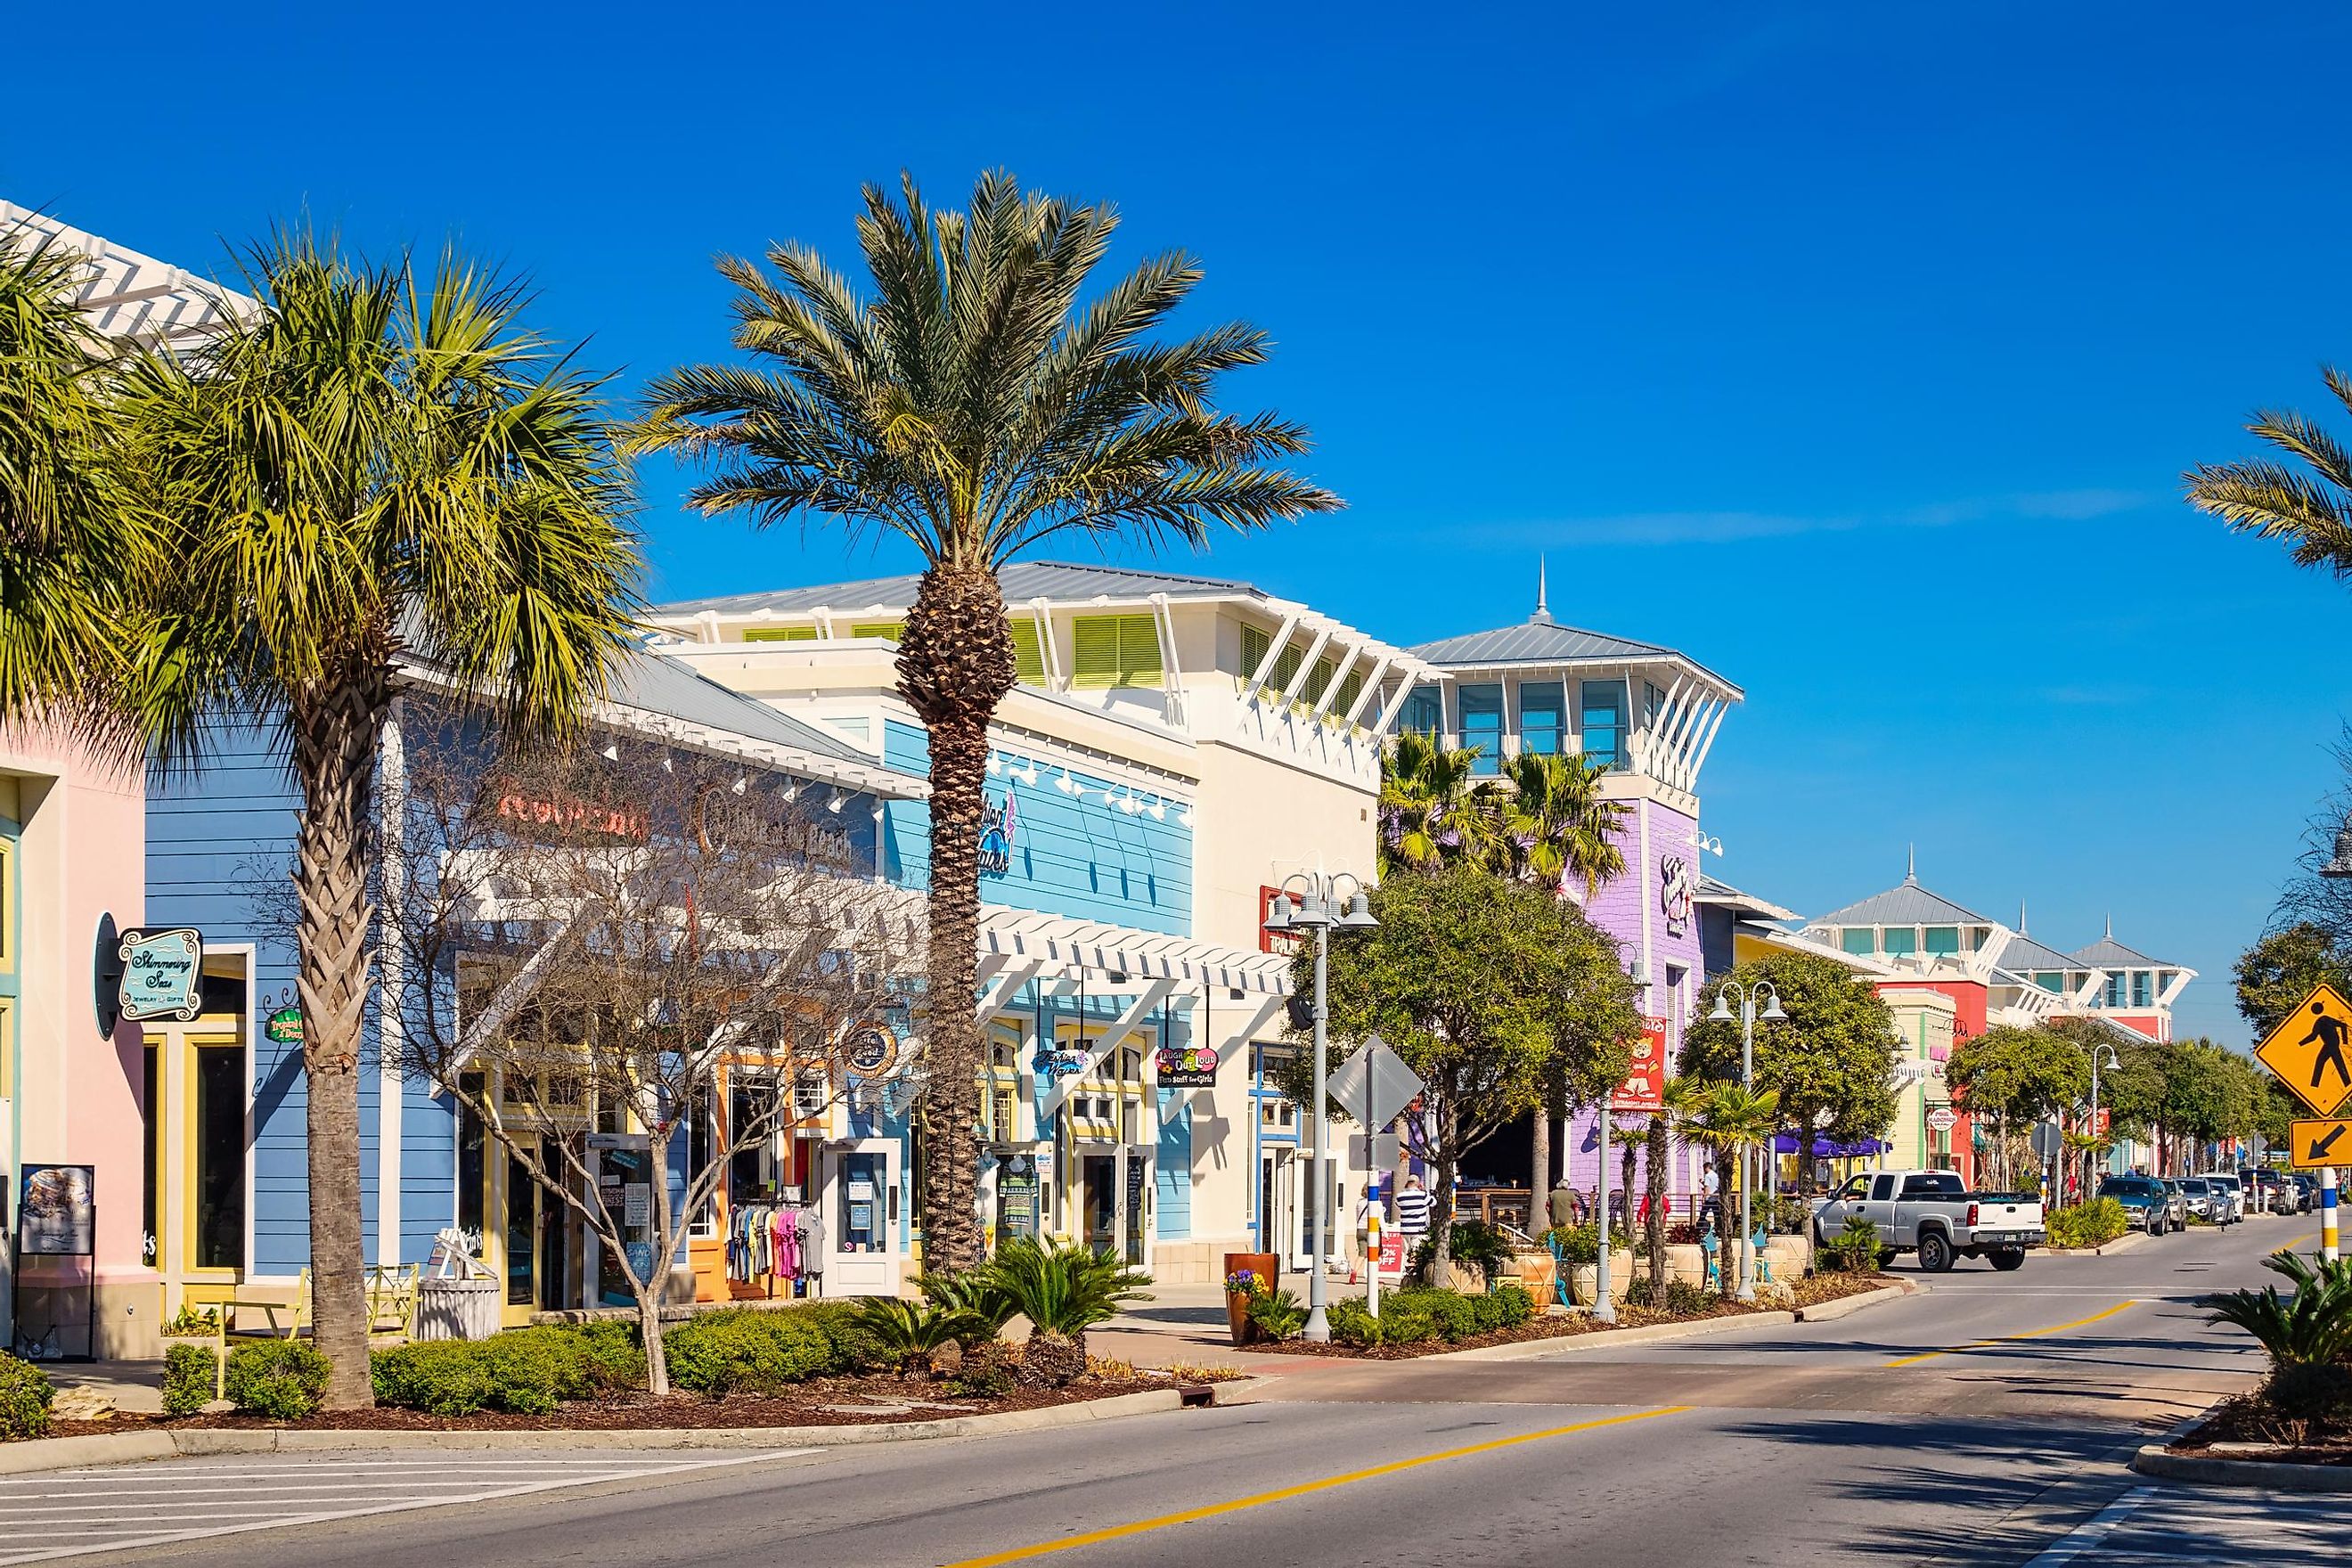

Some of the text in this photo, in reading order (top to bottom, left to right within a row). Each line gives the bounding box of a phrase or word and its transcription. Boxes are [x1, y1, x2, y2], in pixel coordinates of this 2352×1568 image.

[132, 950, 192, 974] Shimmering
[145, 970, 173, 989] Seas
[1158, 1050, 1183, 1064] LAUGH
[1175, 1054, 1215, 1072] OUT LOUD
[1197, 1073, 1213, 1085] Girls
